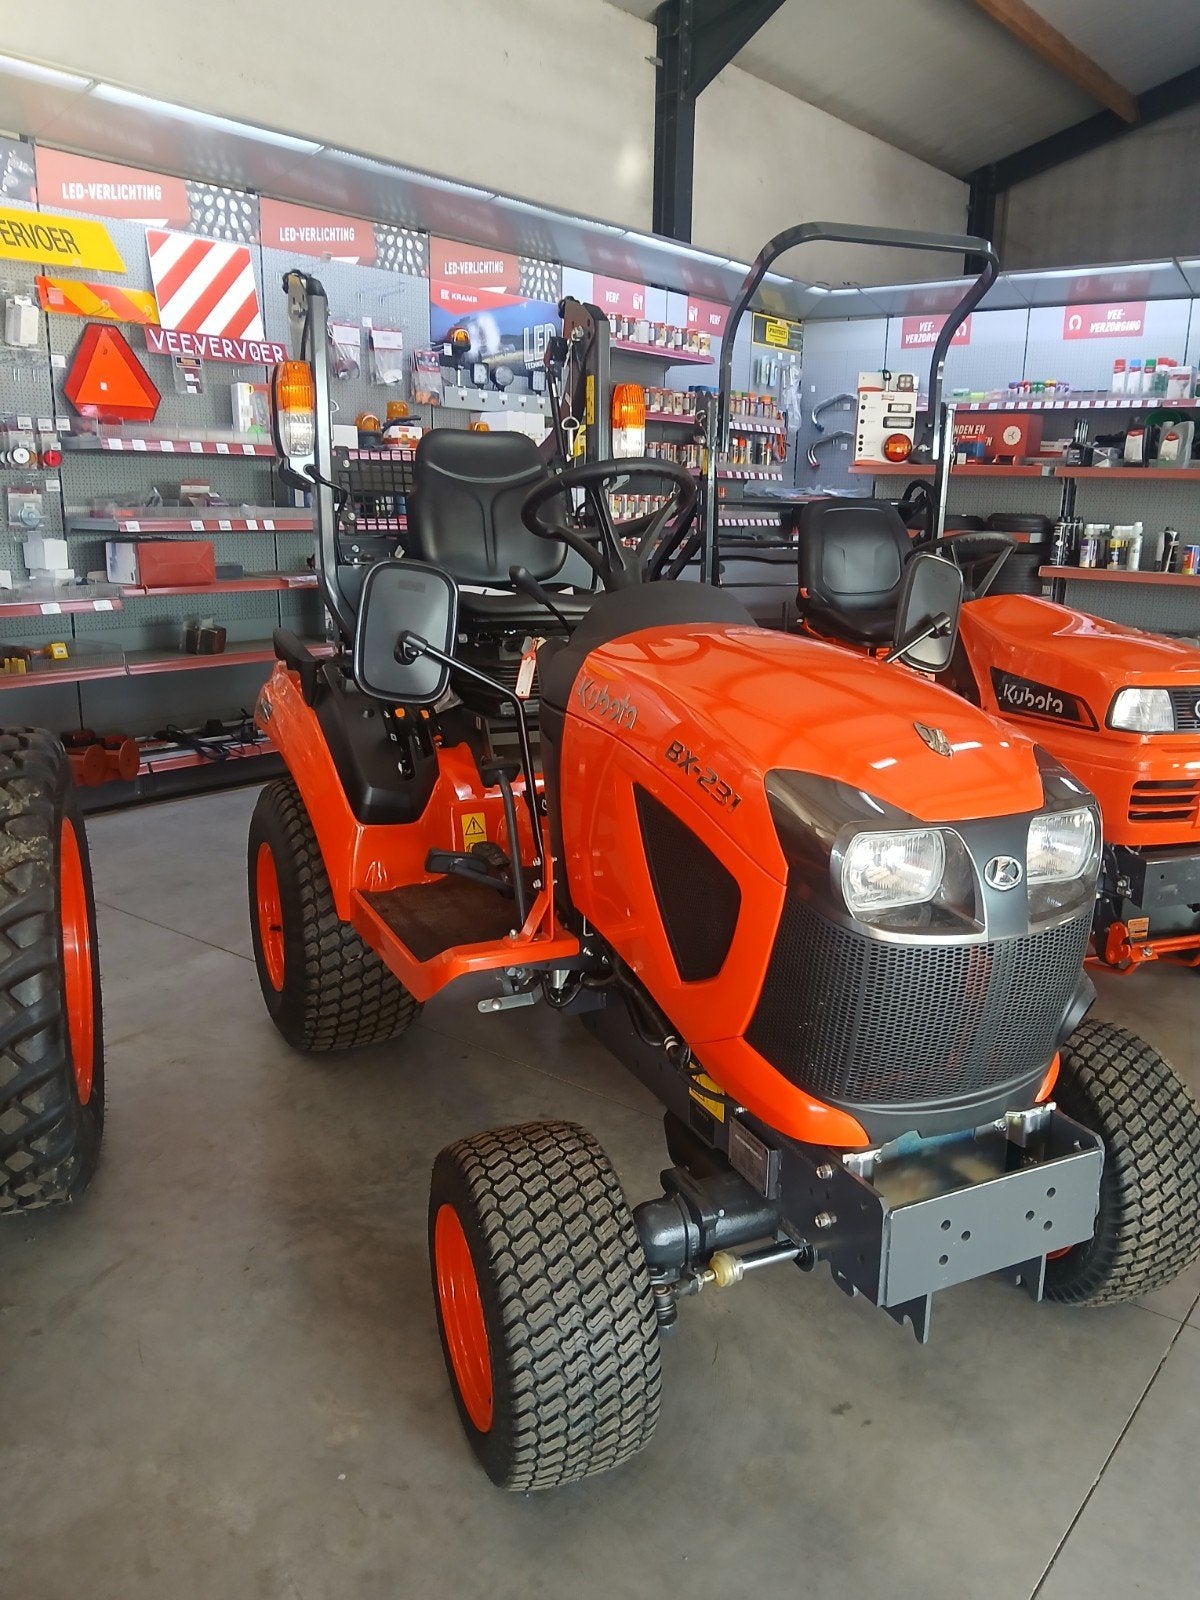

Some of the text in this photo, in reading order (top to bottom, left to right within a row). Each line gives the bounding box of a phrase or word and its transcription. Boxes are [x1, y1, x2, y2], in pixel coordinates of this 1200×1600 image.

[62, 182, 162, 201] LED-VERLICHTING
[279, 227, 355, 242] LED-VERLICHTING
[444, 261, 504, 275] LED-VERLICHTING
[451, 292, 478, 304] KRAMP
[605, 290, 620, 304] VERF
[708, 313, 722, 326] VERF
[1107, 308, 1126, 321] VEE-
[919, 321, 935, 332] VEE-
[1089, 320, 1142, 334] VERZORGING
[148, 328, 284, 363] VEEVERVOER
[954, 425, 974, 435] NDEN
[577, 675, 639, 730] Kubota
[1003, 683, 1064, 714] Kubota
[664, 739, 743, 813] BX-231
